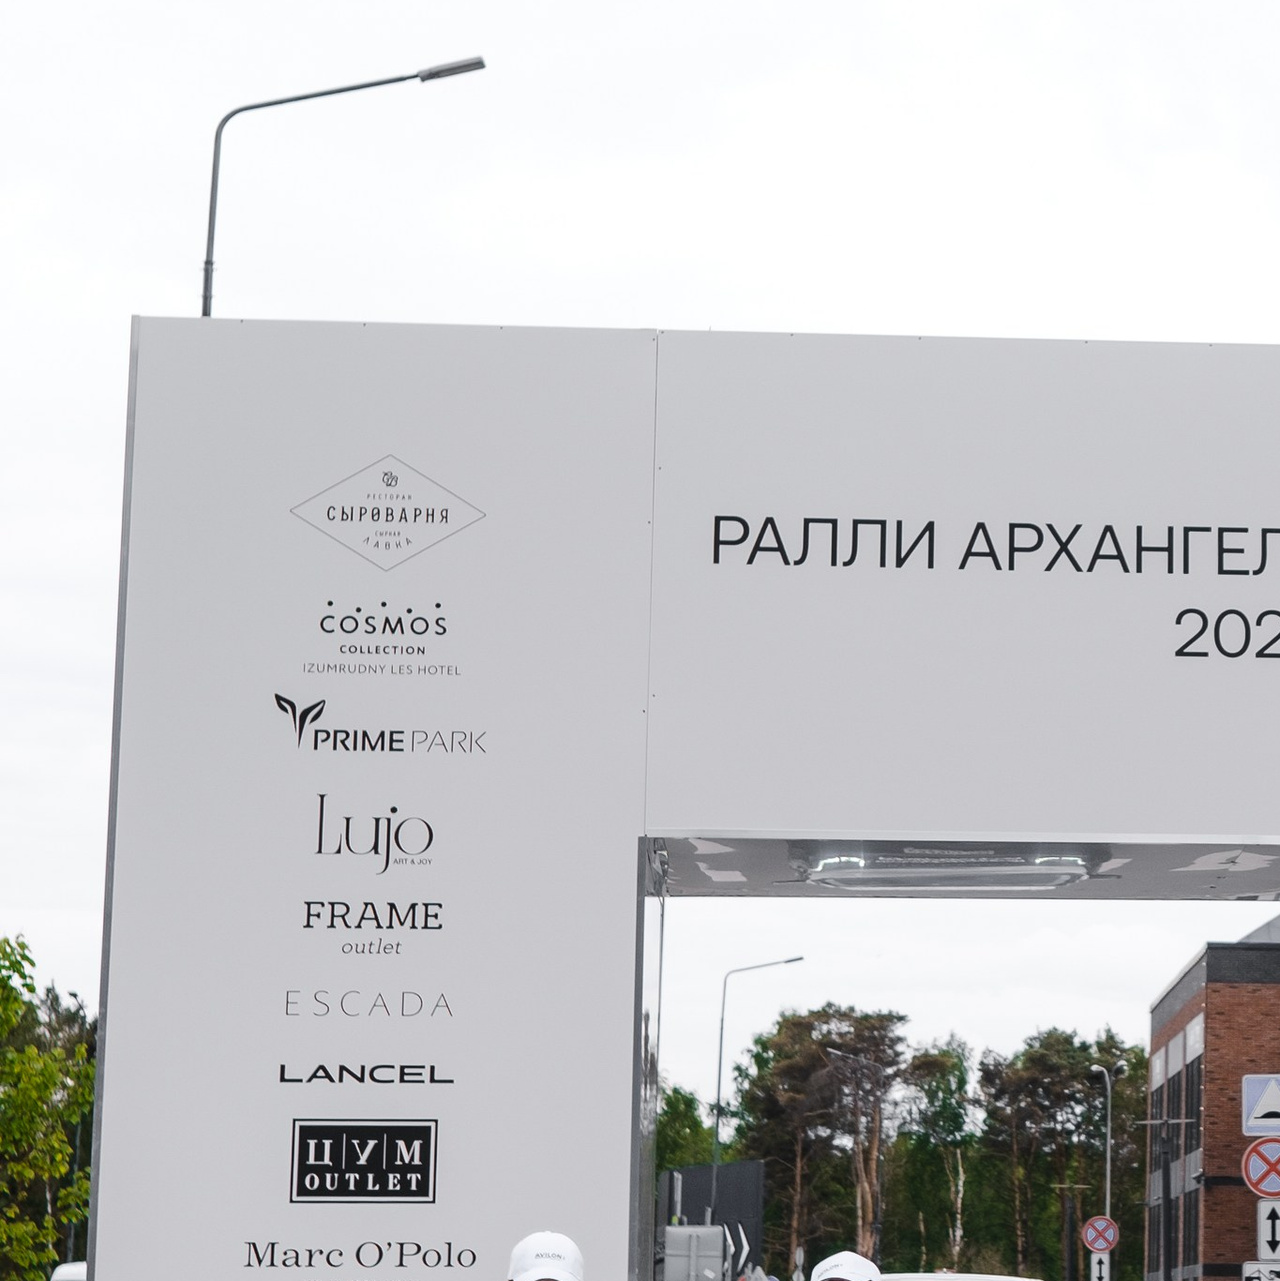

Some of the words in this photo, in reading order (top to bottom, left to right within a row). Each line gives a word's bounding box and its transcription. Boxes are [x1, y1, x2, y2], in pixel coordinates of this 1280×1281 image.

[366, 493, 412, 501] РЕСТОРАН
[326, 505, 449, 524] СЫРОВАРНЯ
[363, 536, 413, 551] ЛАВКА
[713, 515, 936, 570] РАЛЛИ
[320, 614, 447, 636] COSMOS
[339, 644, 426, 656] COLLECTION
[303, 663, 387, 675] IZUMRUDNY
[390, 664, 414, 676] LES
[417, 665, 462, 677] HOTEL
[312, 729, 405, 753] PRIME
[411, 730, 488, 754] PARK
[315, 793, 434, 875] Lujo
[302, 901, 444, 931] FRAME
[341, 938, 403, 956] outlet
[285, 990, 453, 1017] ESCADA
[279, 1064, 455, 1084] LANCEL
[304, 1172, 422, 1192] OUTLET
[244, 1241, 344, 1268] Marc
